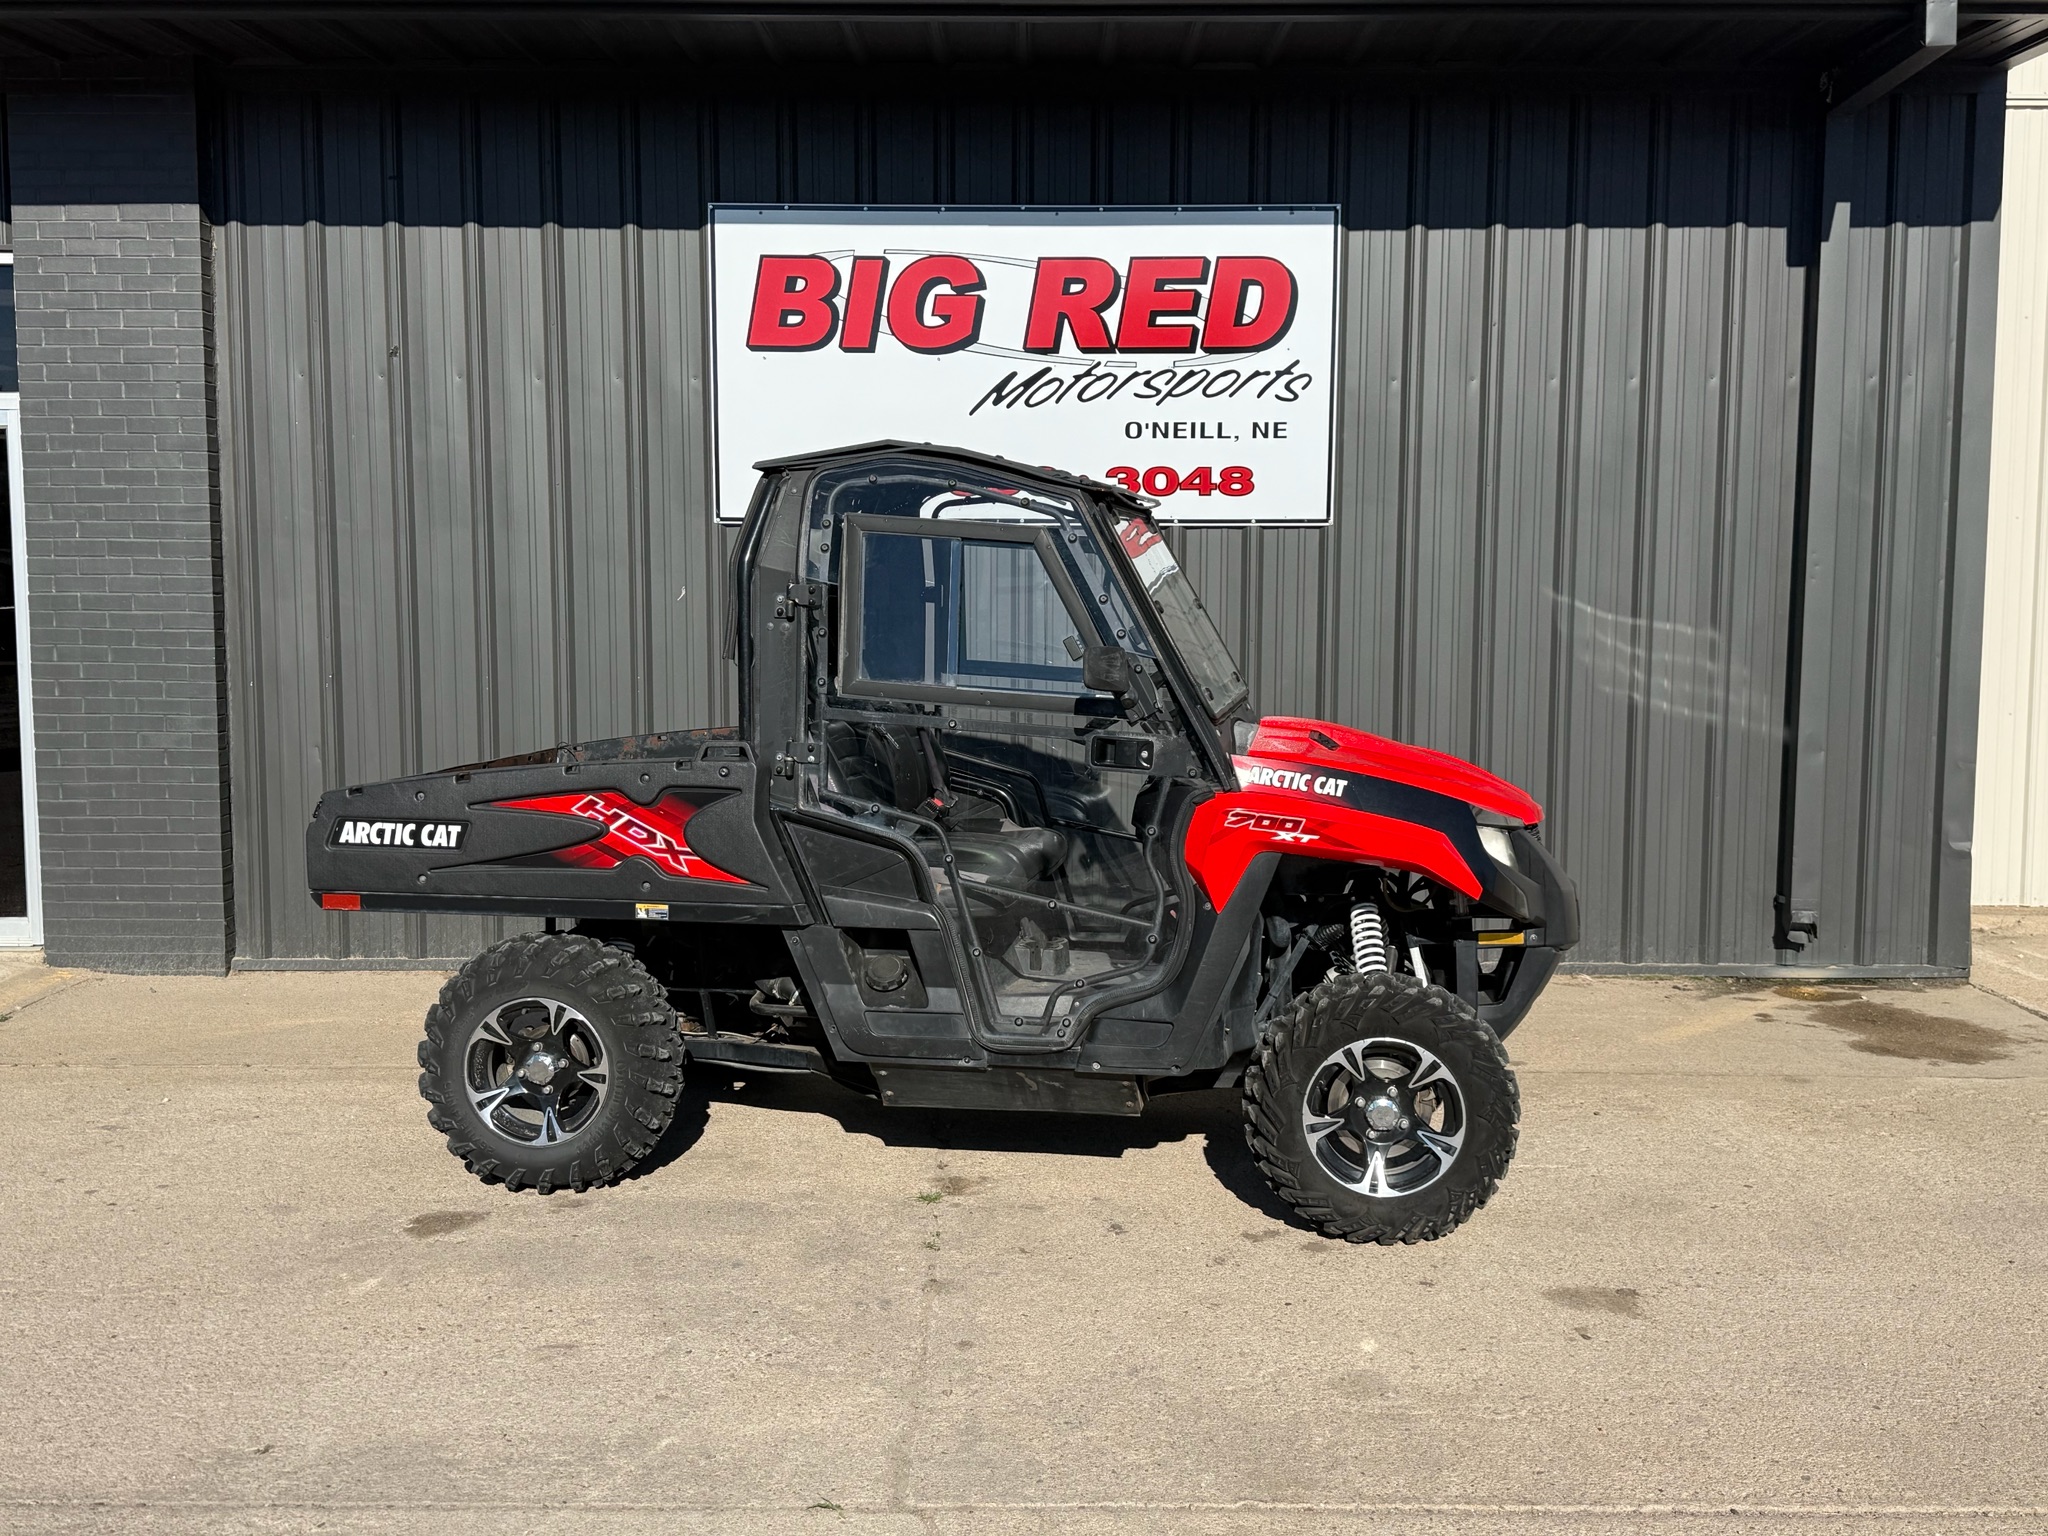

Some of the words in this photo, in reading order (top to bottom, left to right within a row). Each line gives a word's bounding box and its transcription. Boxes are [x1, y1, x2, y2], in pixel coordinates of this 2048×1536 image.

[746, 253, 987, 354] BIG
[1023, 256, 1298, 354] RED
[969, 359, 1312, 416] Motorsports
[1125, 421, 1240, 443] O'NEILL,
[1252, 421, 1288, 439] NE
[1247, 765, 1312, 793] ARCTIC
[1313, 776, 1348, 798] CAT
[338, 822, 417, 846] ARCTIC
[420, 823, 462, 848] CAT
[571, 795, 702, 873] HDX
[1224, 808, 1306, 834] 700
[1270, 830, 1321, 843] XT
